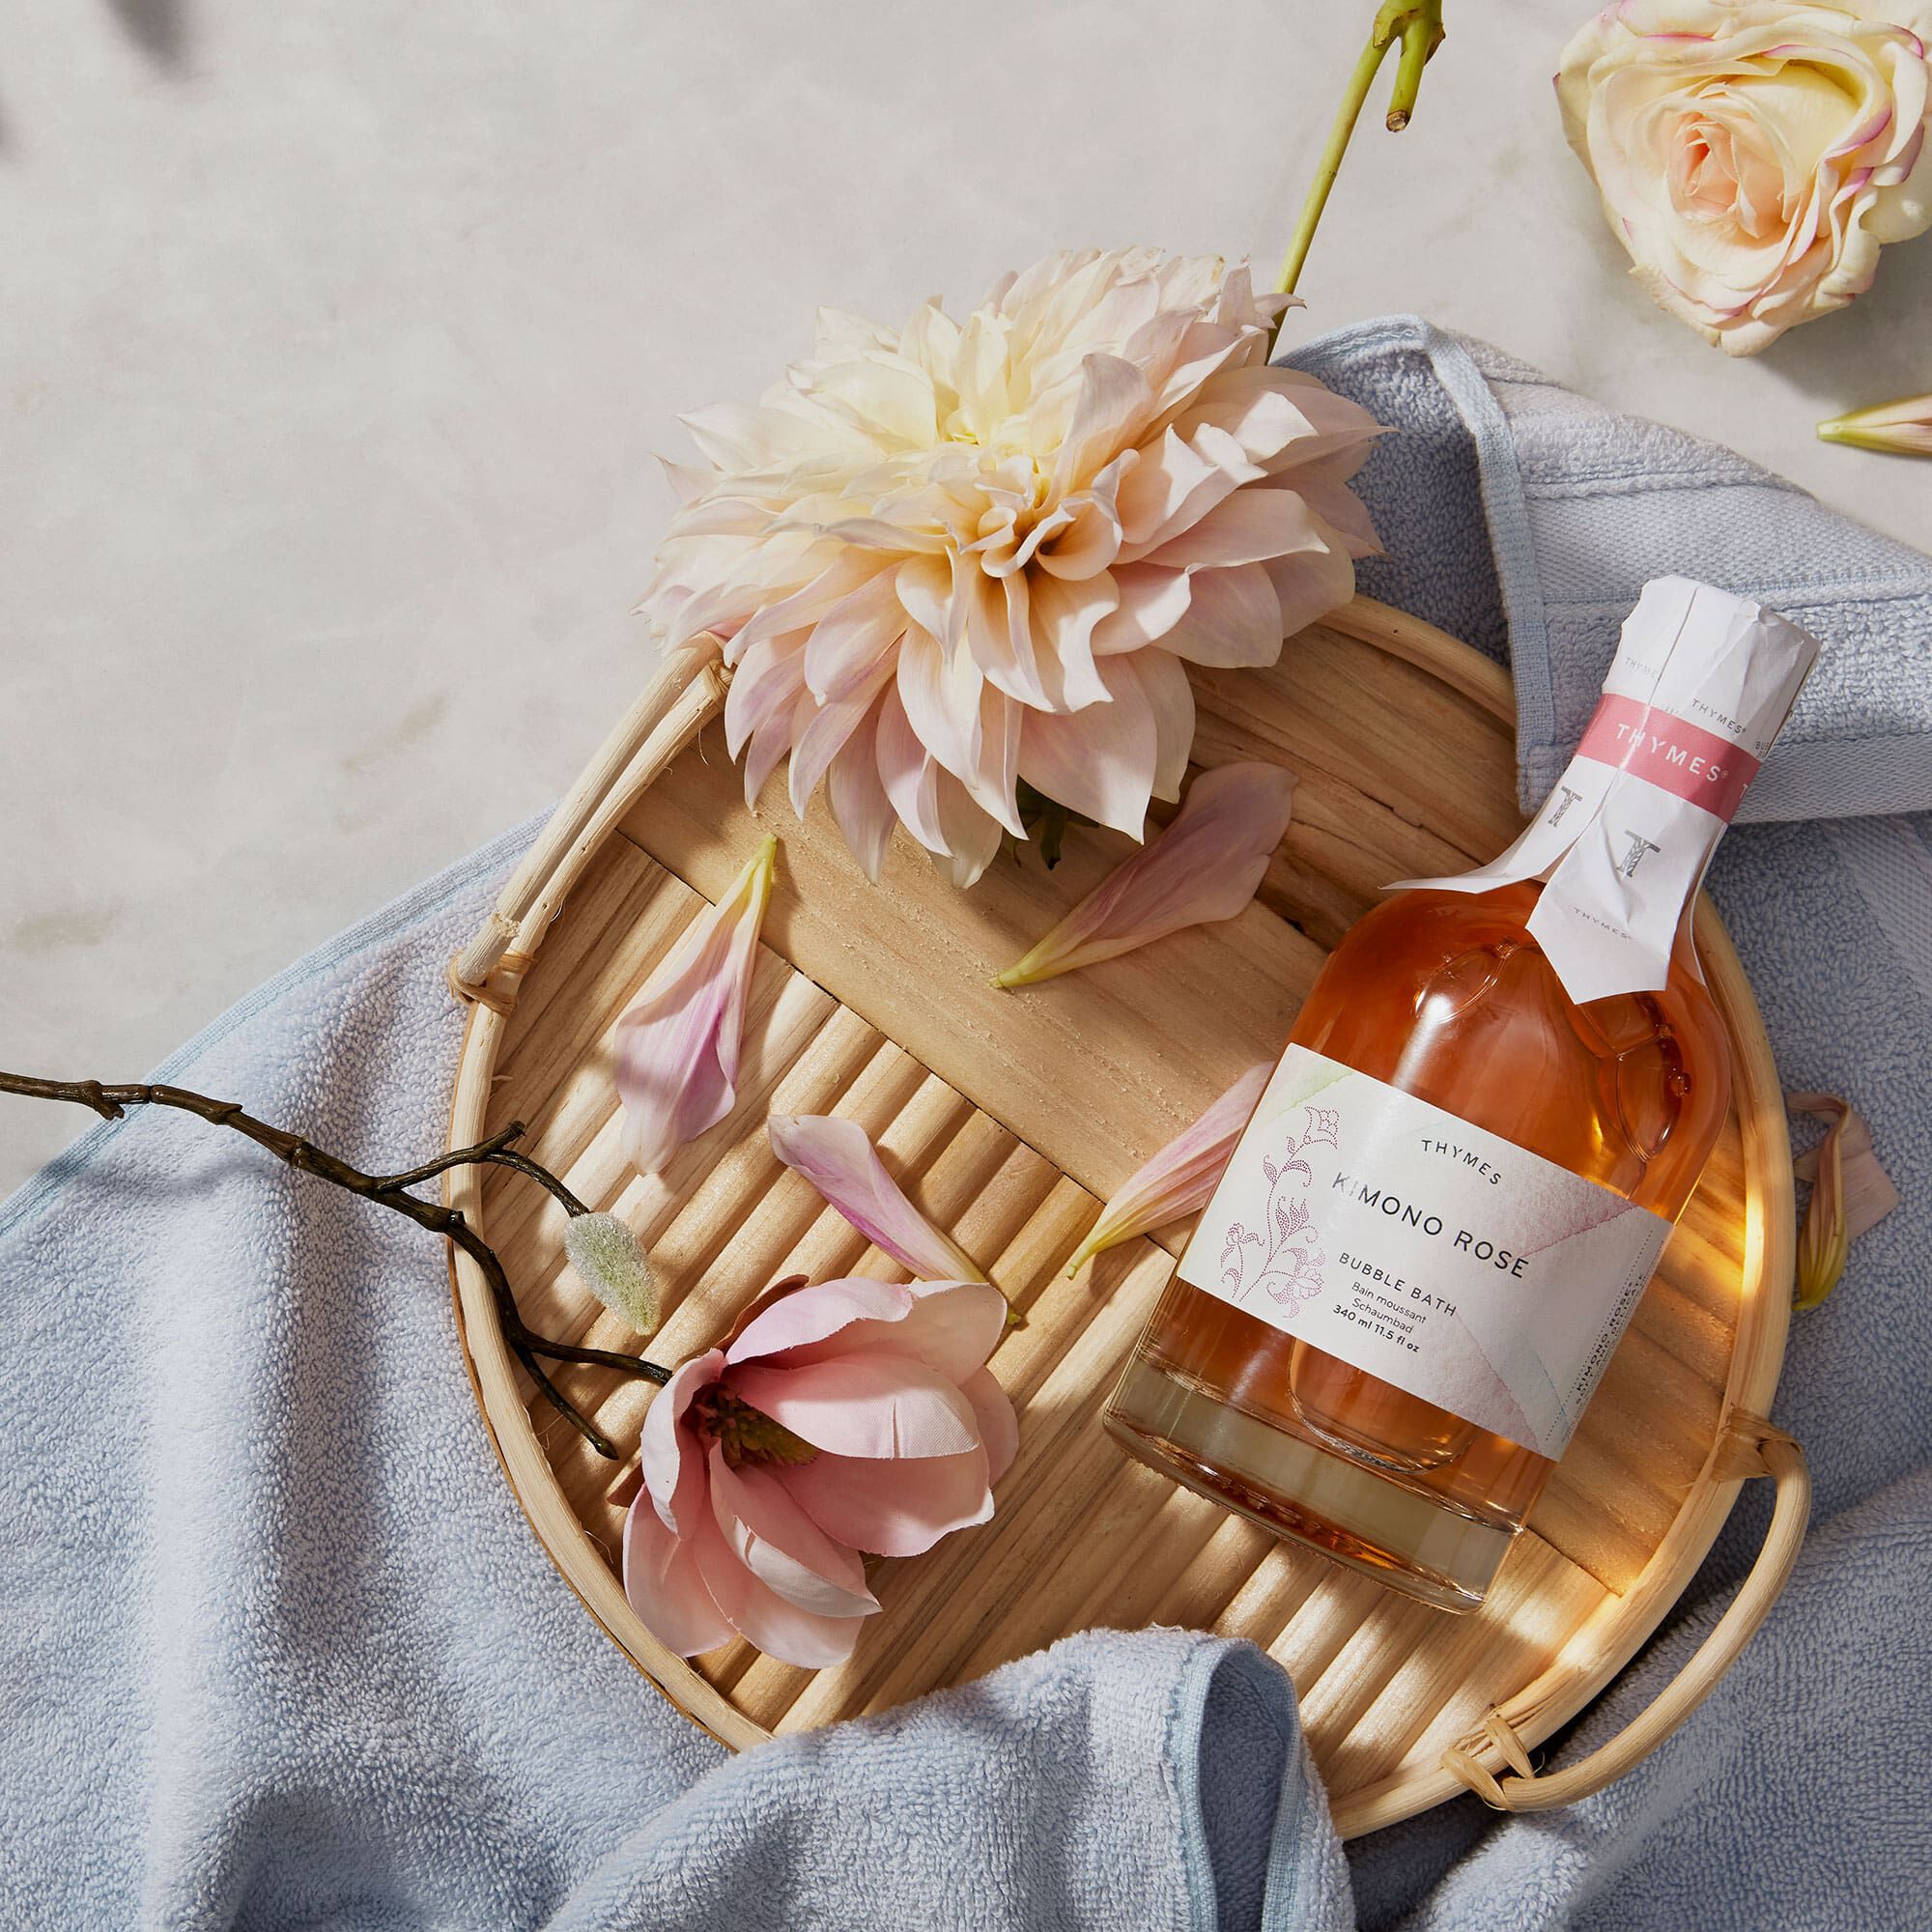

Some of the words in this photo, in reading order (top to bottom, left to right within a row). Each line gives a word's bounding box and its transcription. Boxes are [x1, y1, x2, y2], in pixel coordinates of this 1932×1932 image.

[1421, 1139, 1502, 1185] THYMES
[1332, 1172, 1443, 1236] KIMONO
[1453, 1230, 1529, 1279] ROSE
[1339, 1252, 1406, 1292] BUBBLE
[1410, 1287, 1457, 1317] BATH
[1351, 1281, 1374, 1299] Bain
[1377, 1295, 1427, 1323] moussant
[1333, 1304, 1356, 1321] 340
[1357, 1319, 1373, 1329] ml
[1375, 1324, 1395, 1340] 11.5
[1396, 1335, 1406, 1345] fl
[1406, 1342, 1420, 1353] oz
[1351, 1297, 1414, 1334] Schaumbad
[1577, 1333, 1608, 1391] KIMONO
[1596, 1341, 1610, 1366] AND
